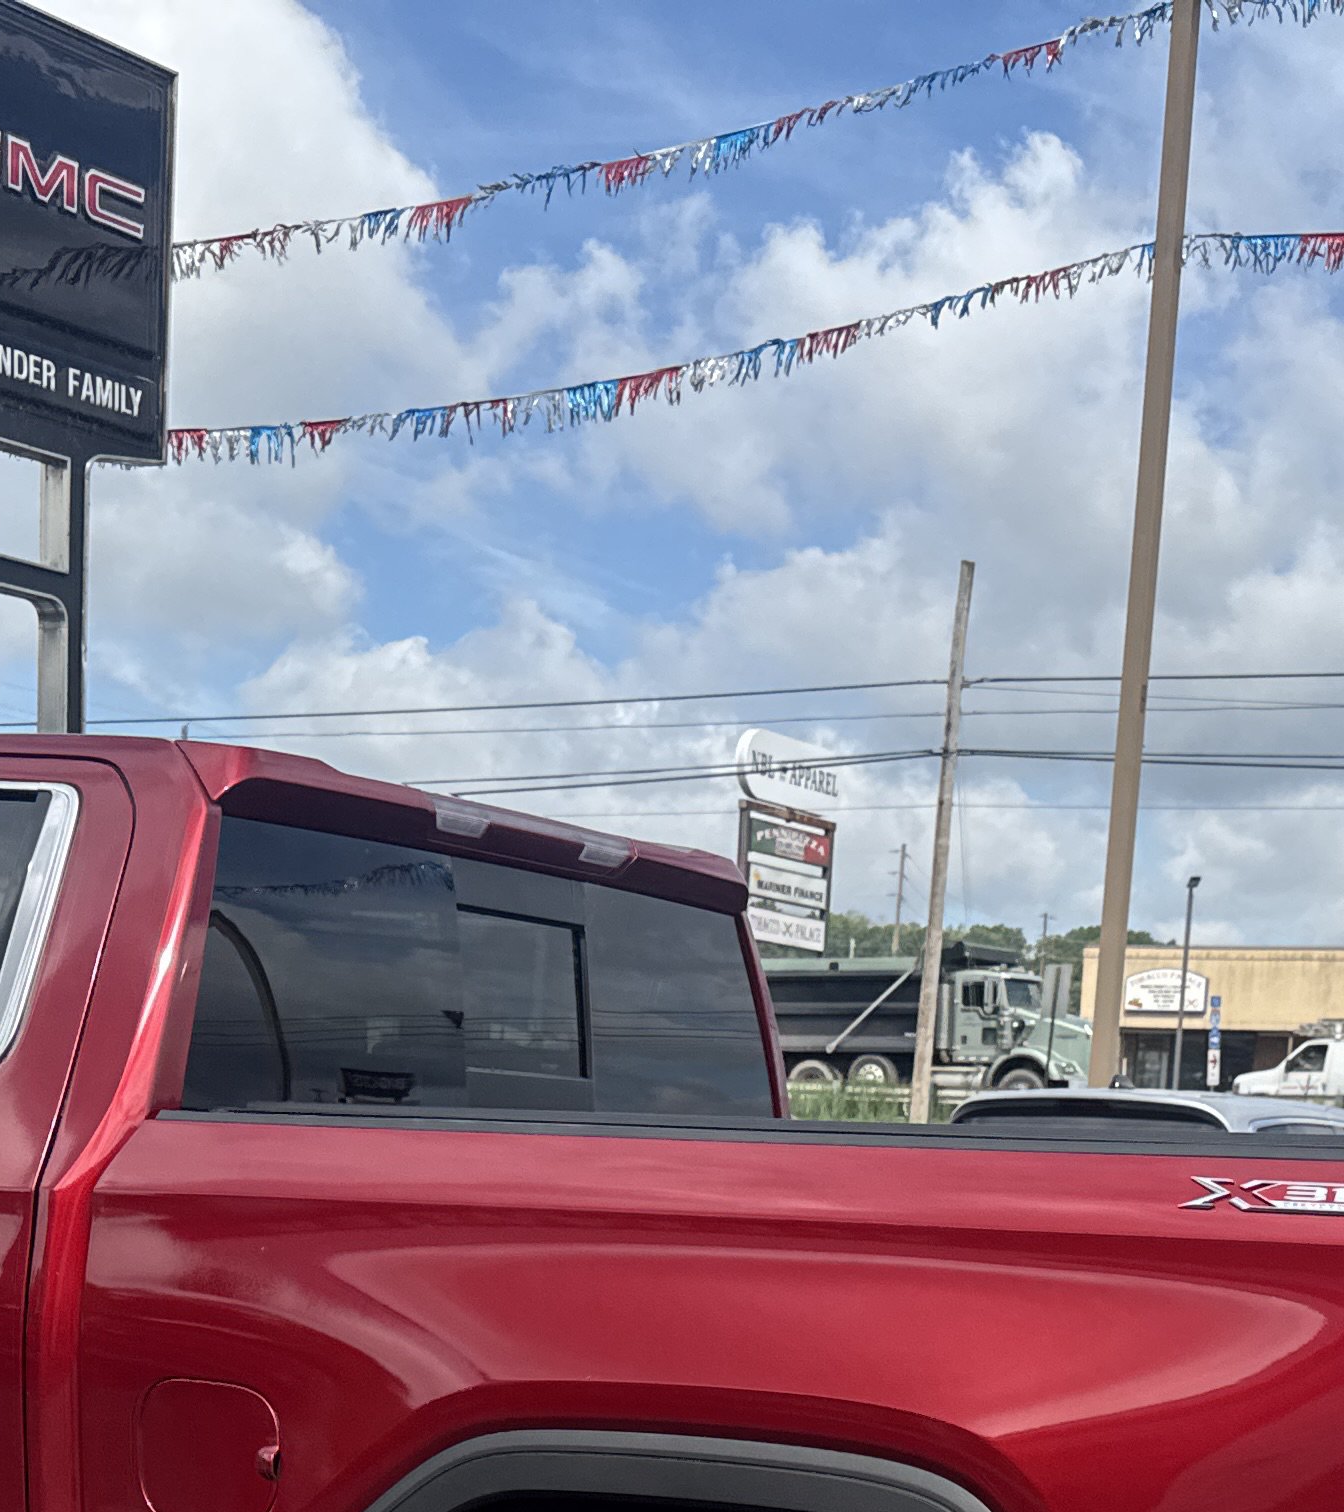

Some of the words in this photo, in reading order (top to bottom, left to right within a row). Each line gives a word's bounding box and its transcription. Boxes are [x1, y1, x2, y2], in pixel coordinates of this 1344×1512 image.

[67, 367, 143, 417] FAMILY
[789, 763, 839, 797] APPAREL
[757, 880, 792, 896] MARINER
[794, 886, 823, 903] FINANCE
